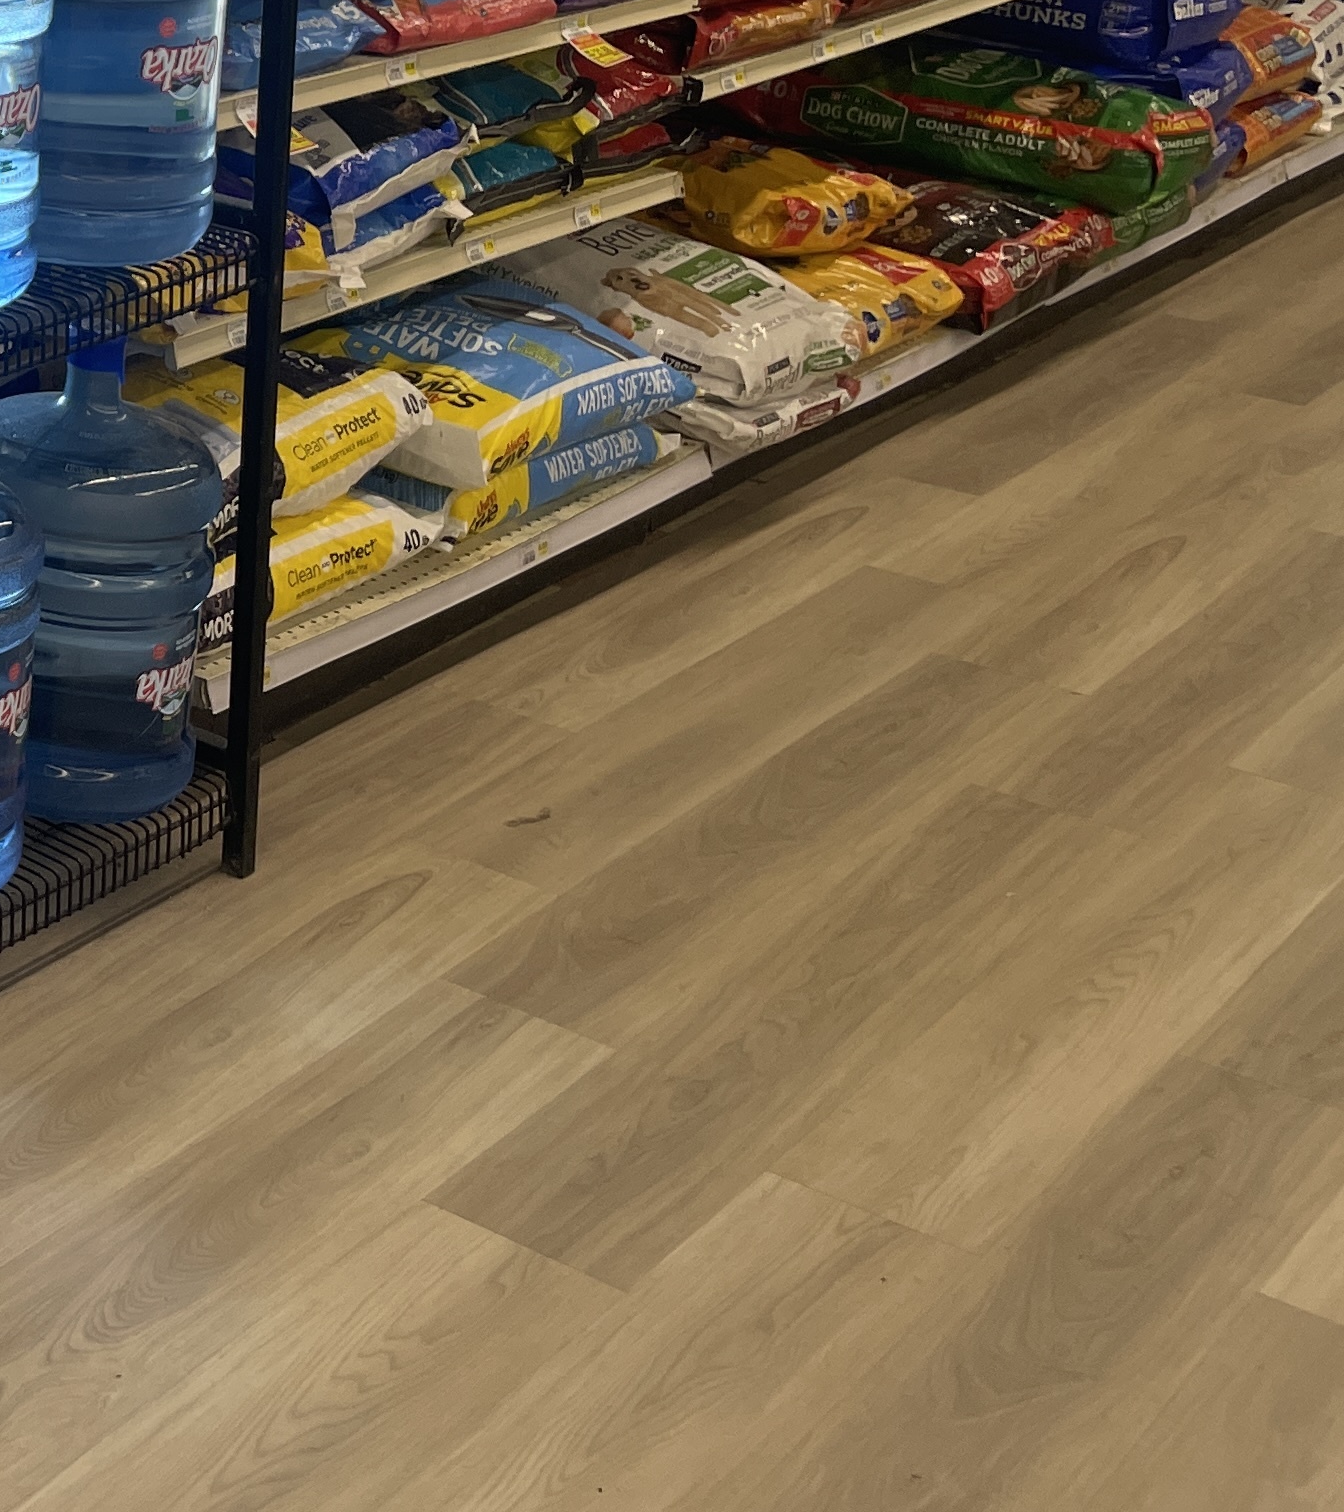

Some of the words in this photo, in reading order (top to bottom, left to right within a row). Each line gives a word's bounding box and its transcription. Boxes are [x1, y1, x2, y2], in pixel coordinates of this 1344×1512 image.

[984, 1, 1087, 31] HUNKS
[140, 35, 219, 91] Ozarka
[807, 98, 843, 119] DOG
[846, 106, 902, 131] CHOW
[964, 109, 1010, 129] SMART
[915, 116, 991, 140] COMPLETE
[996, 131, 1047, 153] ADULT
[576, 219, 657, 257] Bene
[576, 384, 616, 417] WATER
[292, 434, 327, 462] Clean
[332, 406, 382, 441] Protect
[543, 449, 586, 484] WATER
[586, 426, 643, 469] SOFTENER
[402, 528, 421, 554] 40
[287, 560, 322, 589] Clean
[329, 537, 378, 569] Protect
